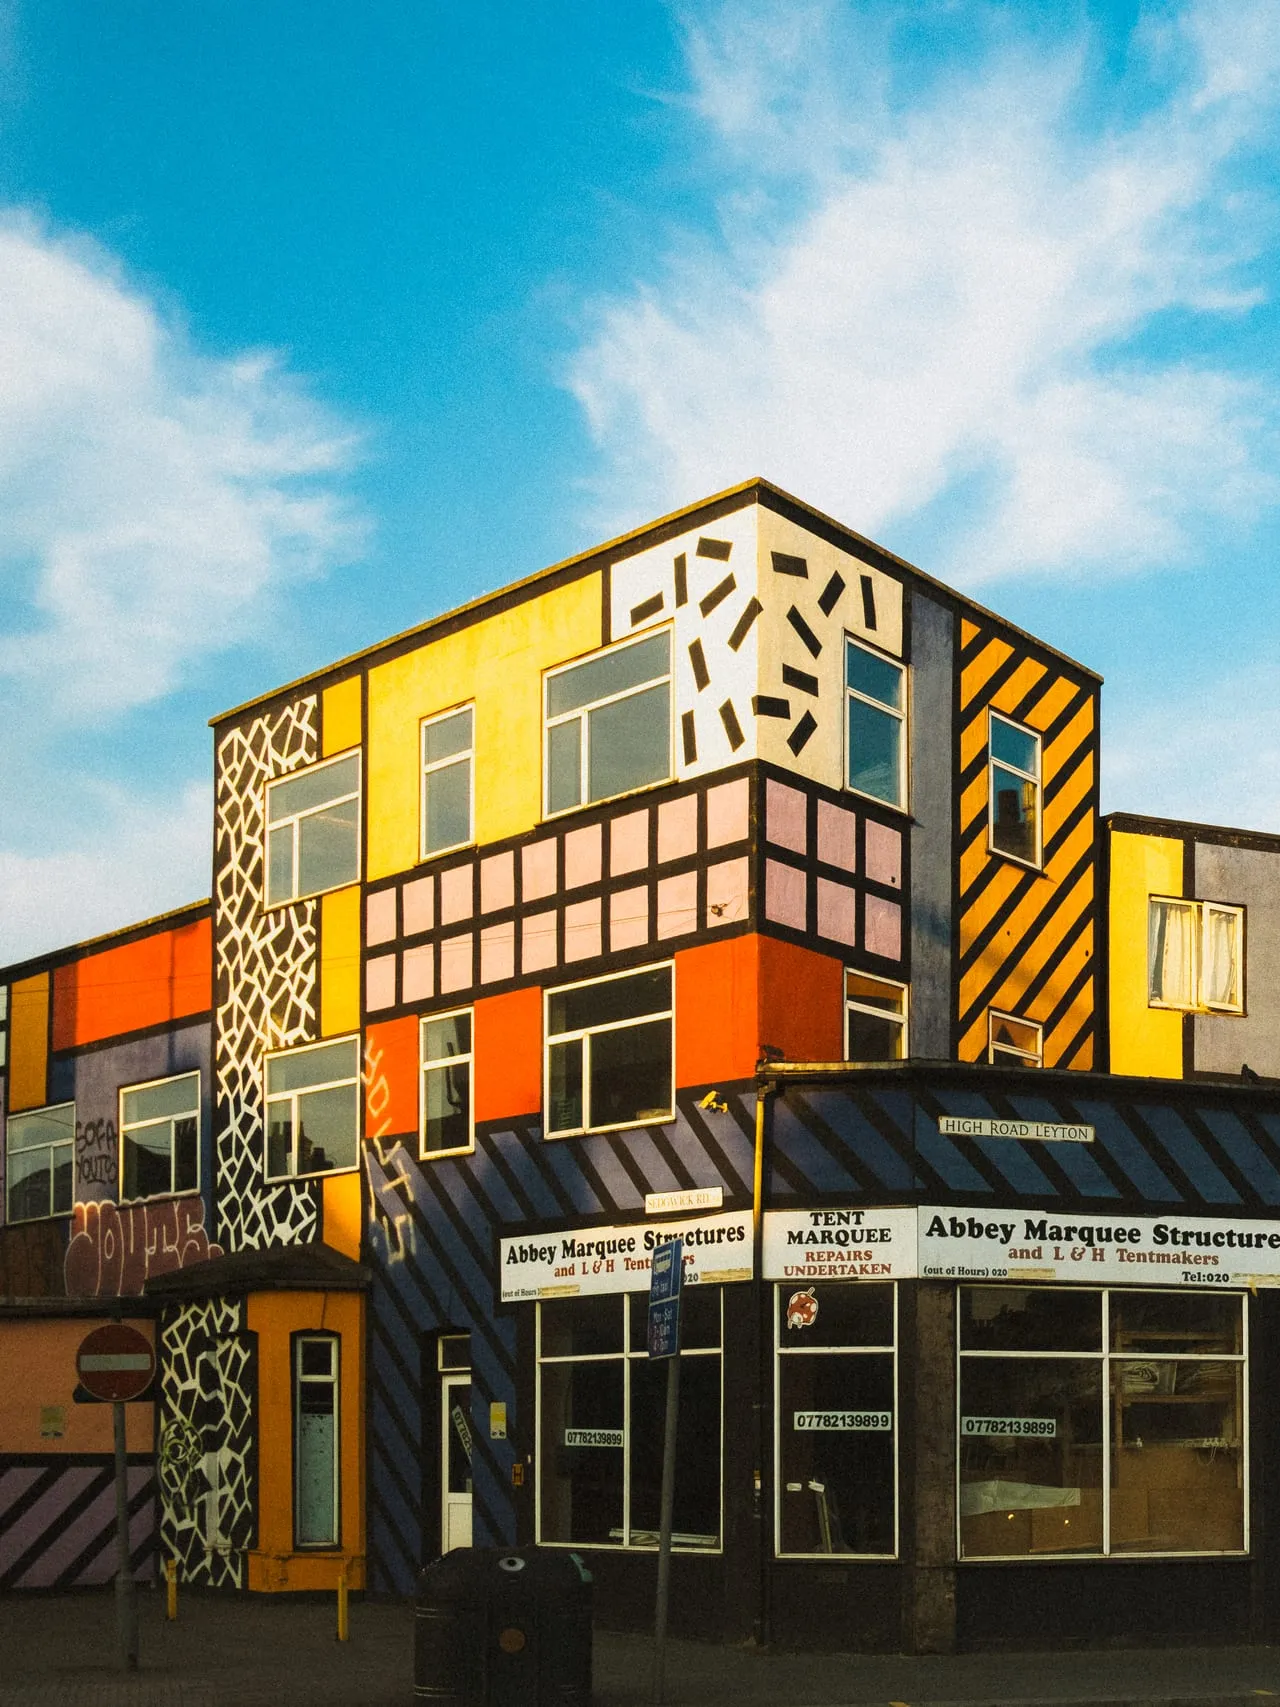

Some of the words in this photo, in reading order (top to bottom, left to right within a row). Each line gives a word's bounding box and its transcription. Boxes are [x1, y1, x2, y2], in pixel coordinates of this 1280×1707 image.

[75, 1118, 118, 1153] SOFA
[945, 1119, 983, 1133] HIGH
[991, 1121, 1029, 1136] ROAD
[1036, 1125, 1088, 1139] LEYTON
[809, 1211, 865, 1226] TENT
[786, 1228, 892, 1247] MARQUEE
[925, 1215, 1016, 1245] Abbey
[1023, 1219, 1141, 1247] Marquee
[506, 1243, 557, 1265] Abbey
[562, 1237, 636, 1259] Marquee
[805, 1250, 873, 1262] REPAIRS
[1008, 1246, 1043, 1260] and
[1053, 1246, 1065, 1260] L
[1070, 1247, 1087, 1261] &
[1091, 1248, 1105, 1262] H
[1116, 1248, 1220, 1266] Tentmakers
[554, 1263, 575, 1278] and
[582, 1262, 589, 1275] L
[592, 1261, 603, 1274] &
[605, 1259, 615, 1273] H
[624, 1255, 695, 1271] Tentrs
[783, 1263, 892, 1276] UNDERTAKEN
[923, 1265, 943, 1276] (out
[945, 1266, 956, 1276] of
[957, 1266, 989, 1277] Hours)
[991, 1268, 1008, 1277] 020
[1181, 1271, 1230, 1283] Tel:020
[797, 1414, 889, 1428] 07782139899
[966, 1420, 1055, 1434] 07782139899
[567, 1431, 622, 1446] 07782139899
